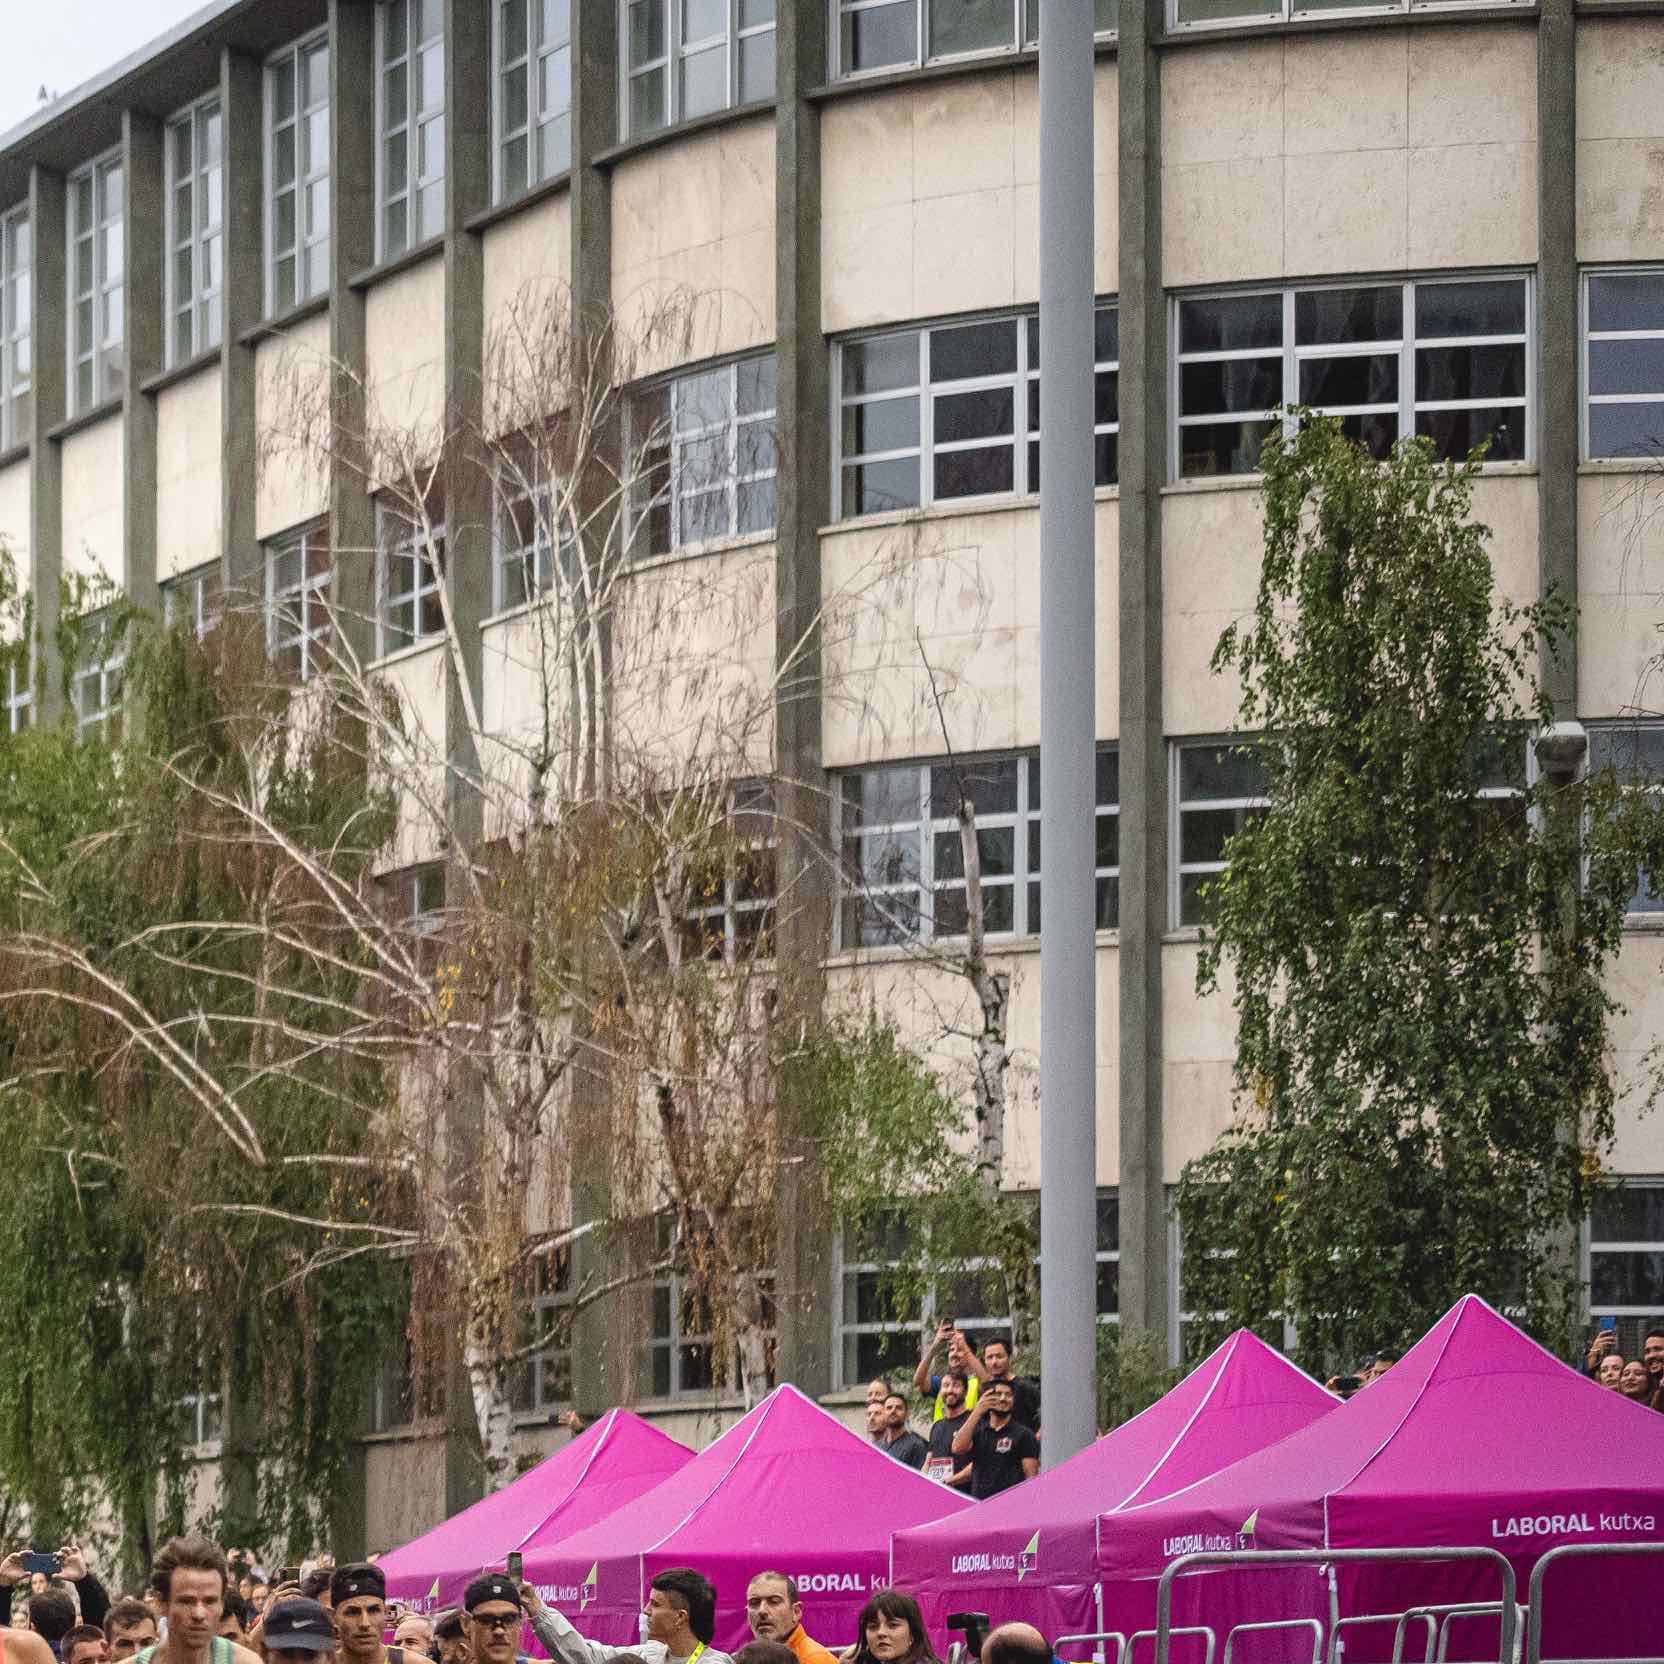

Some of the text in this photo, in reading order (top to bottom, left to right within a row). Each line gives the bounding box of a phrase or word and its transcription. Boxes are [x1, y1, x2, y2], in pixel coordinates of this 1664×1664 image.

[1492, 1512, 1656, 1538] LABORAL kutxa
[1164, 1533, 1232, 1556] LABORAL kutxa
[952, 1553, 1015, 1574] LABORAL kutxa
